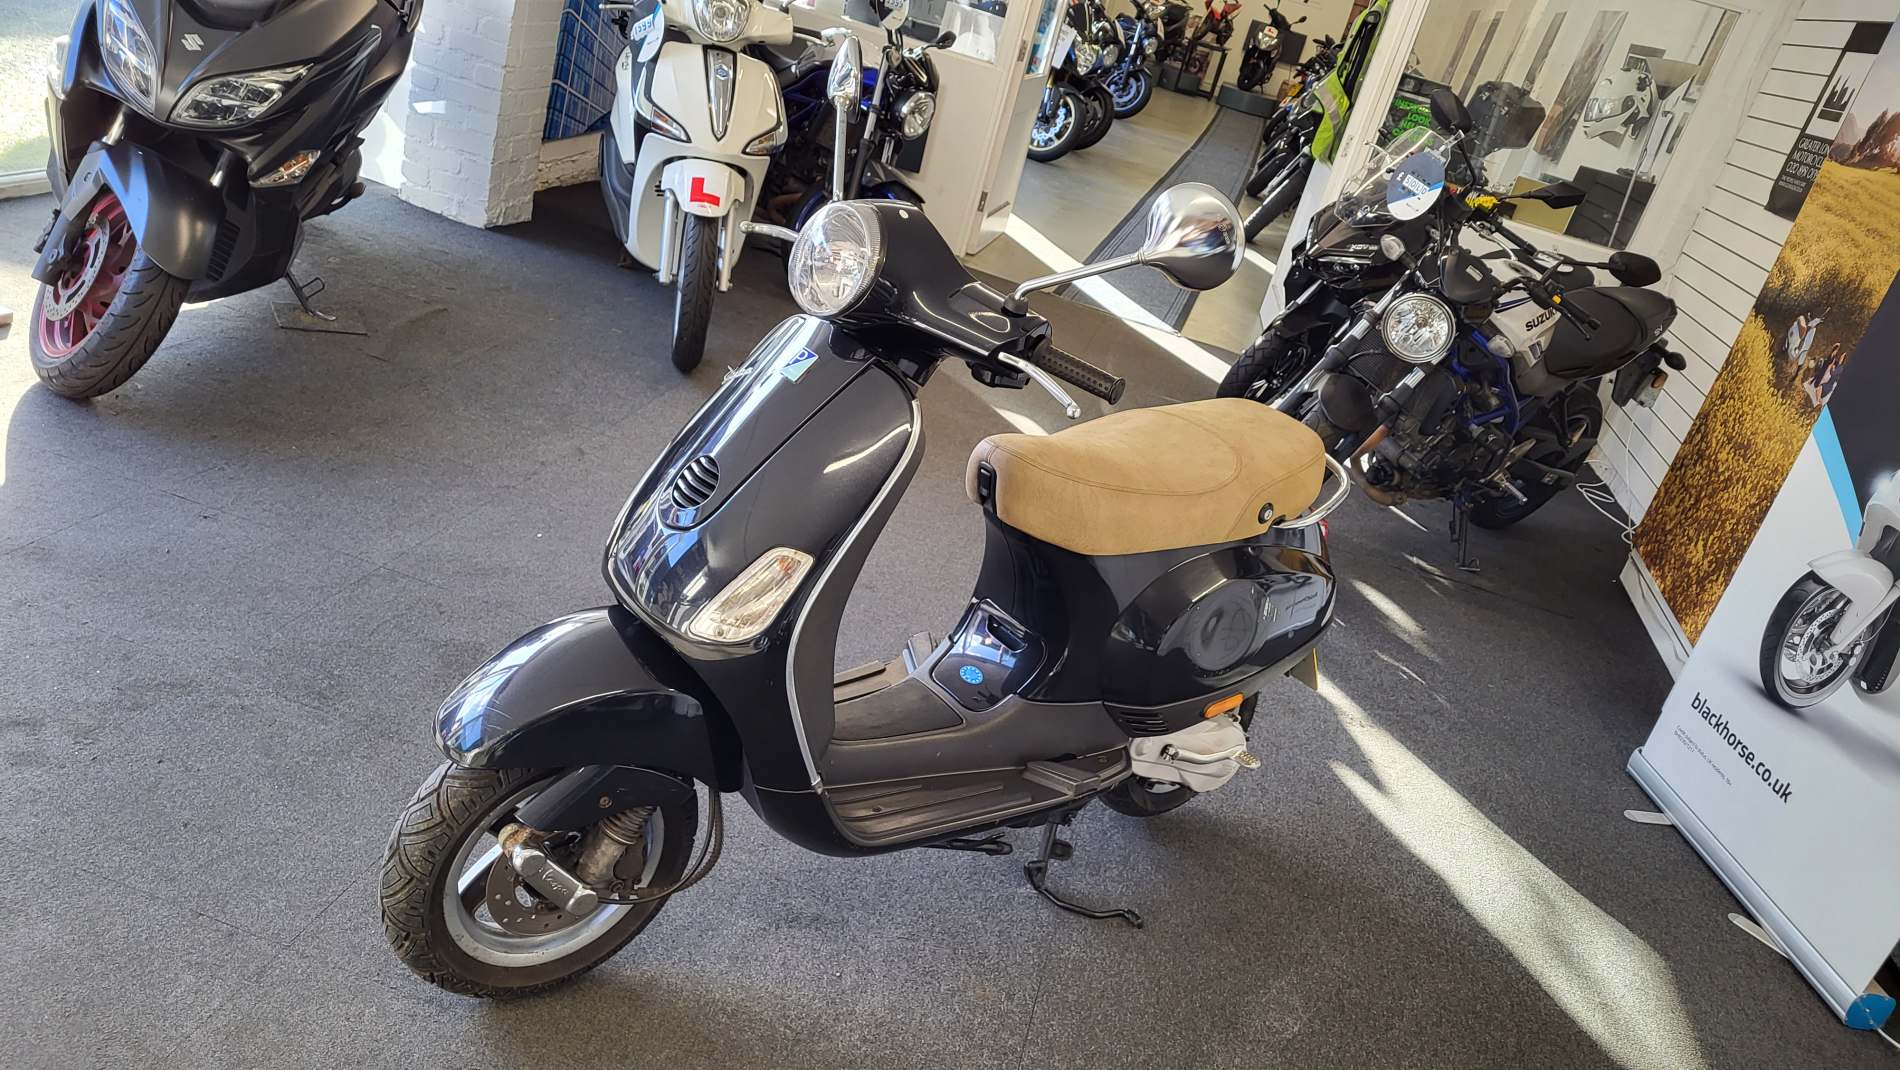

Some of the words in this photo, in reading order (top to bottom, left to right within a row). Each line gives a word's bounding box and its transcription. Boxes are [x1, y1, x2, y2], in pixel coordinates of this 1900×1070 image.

[690, 177, 721, 207] L
[1404, 176, 1428, 195] SOLD
[1525, 309, 1557, 331] SUZUK
[1691, 692, 1793, 804] blackhorse.co.uk
